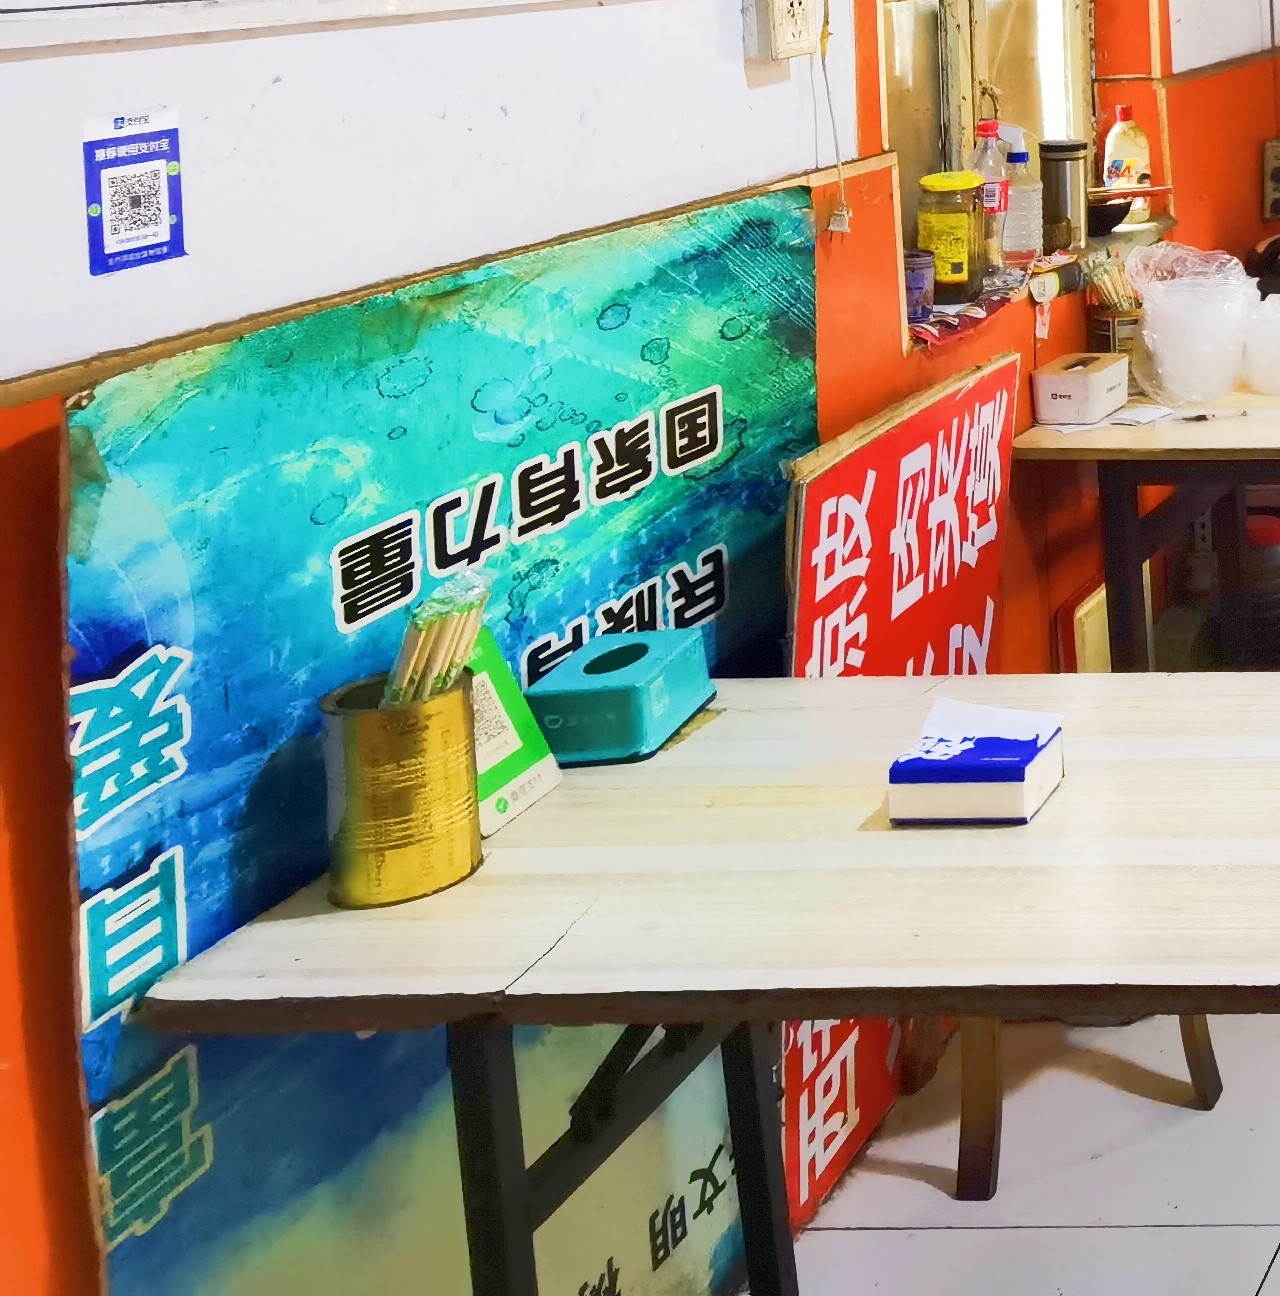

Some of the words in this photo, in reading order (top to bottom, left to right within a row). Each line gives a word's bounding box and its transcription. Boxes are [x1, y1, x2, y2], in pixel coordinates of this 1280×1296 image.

[336, 388, 722, 631] 国家有力量
[68, 646, 192, 840] 爱
